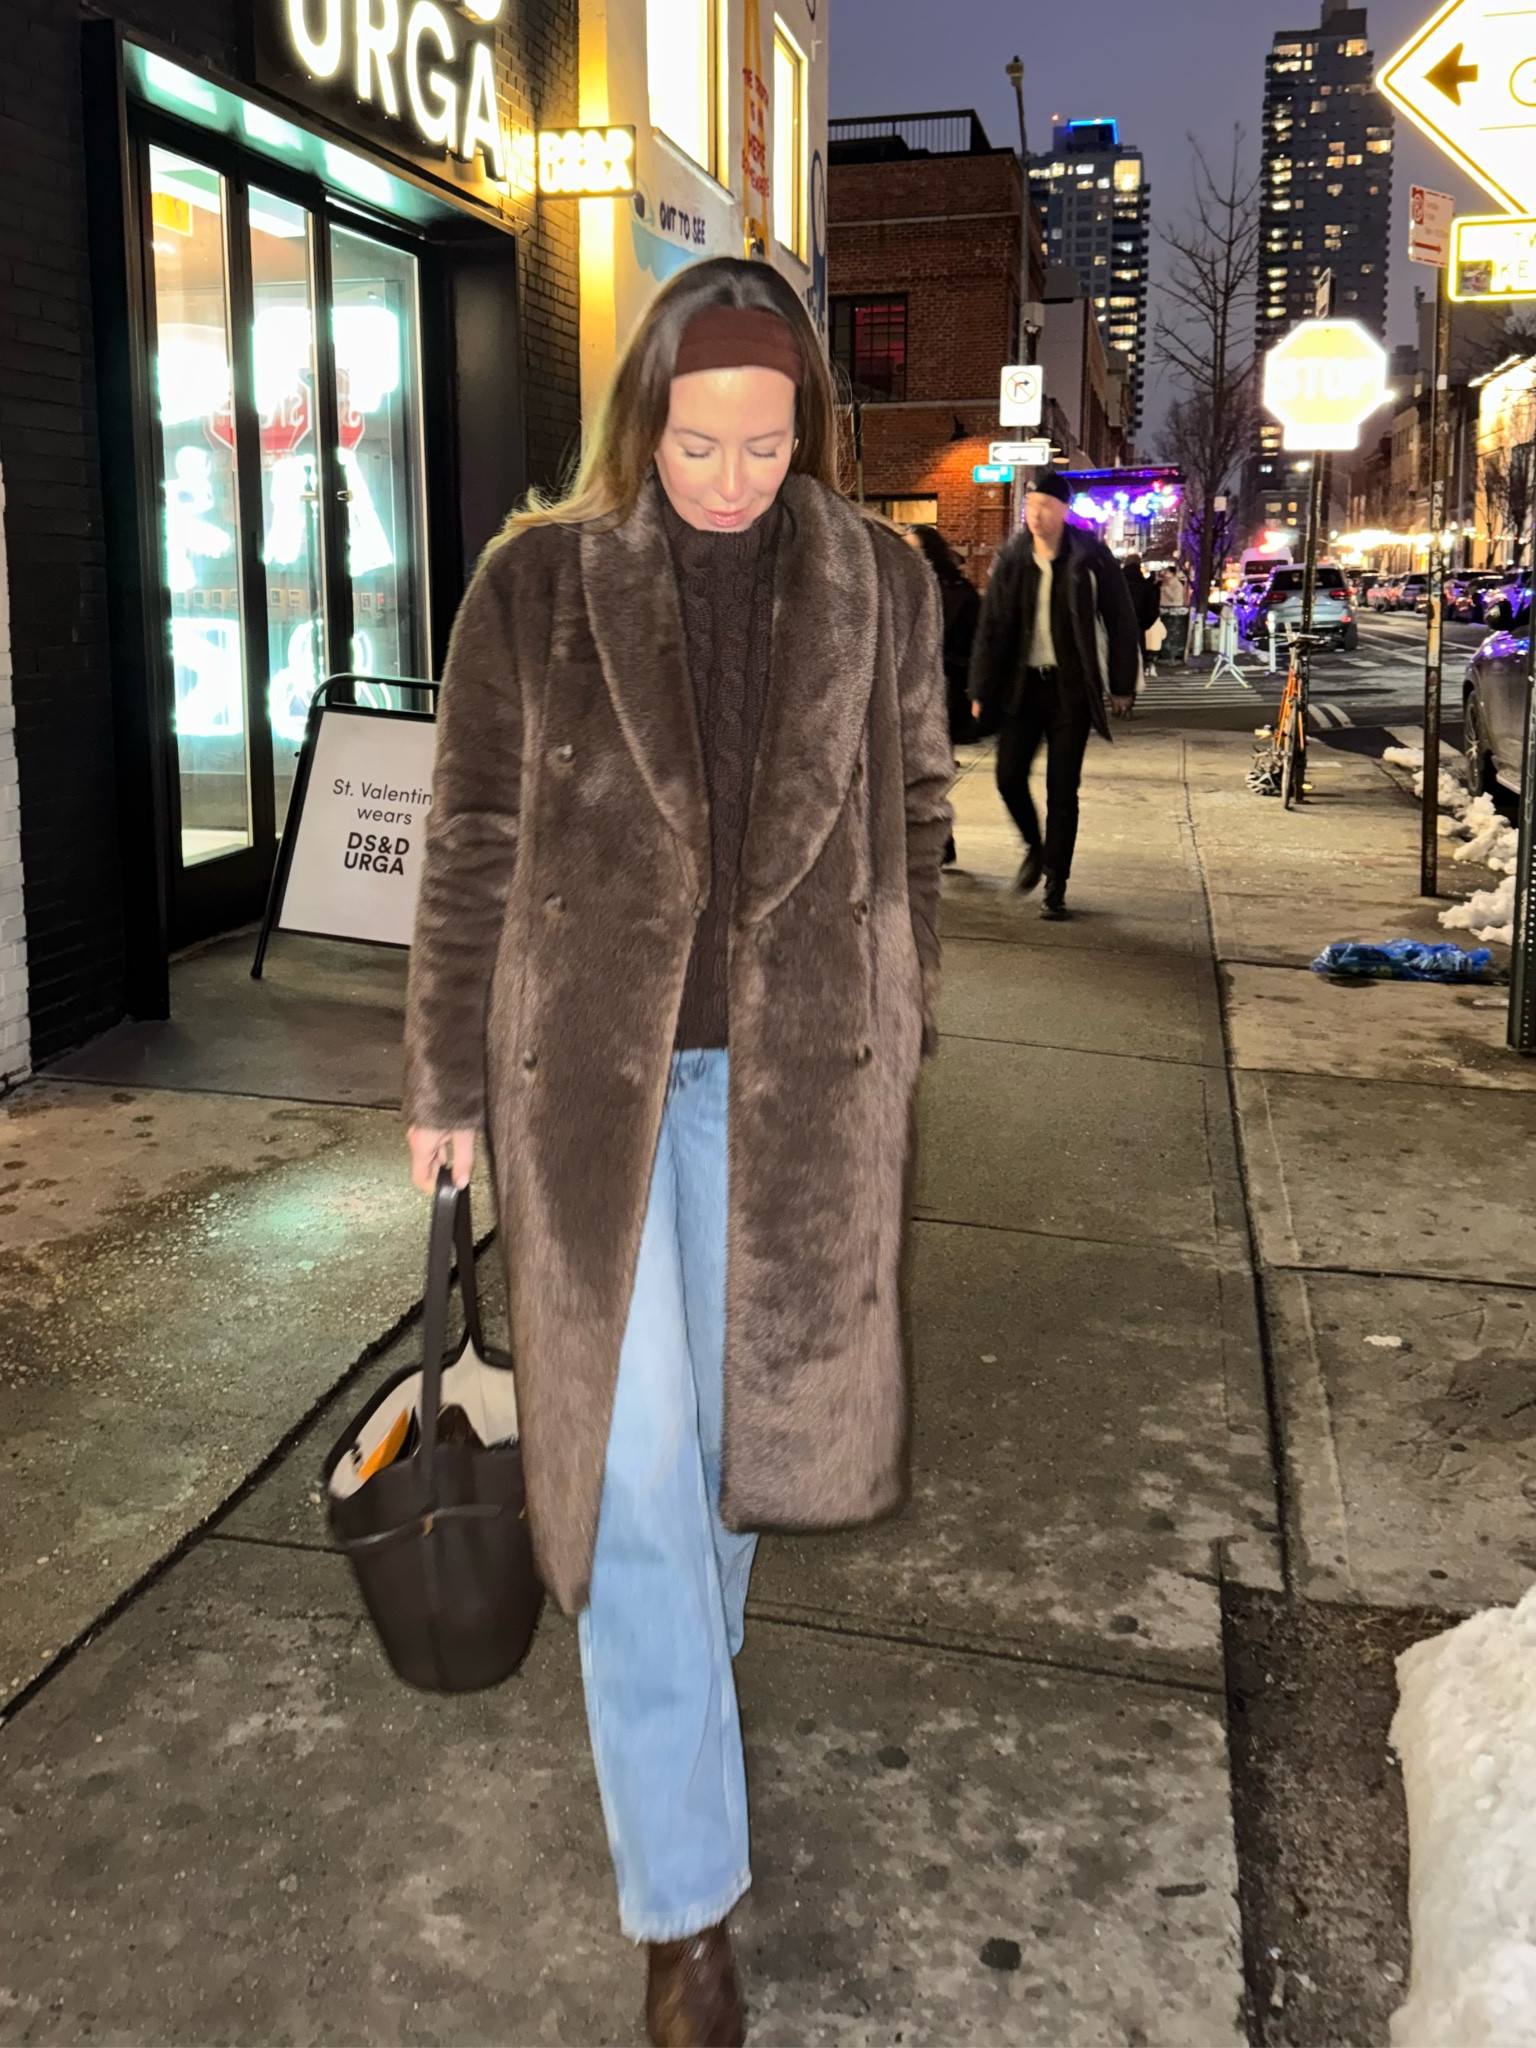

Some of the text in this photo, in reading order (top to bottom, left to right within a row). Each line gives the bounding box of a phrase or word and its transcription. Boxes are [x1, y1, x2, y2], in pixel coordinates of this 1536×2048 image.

[660, 201, 706, 245] OUT TO SEE
[1274, 356, 1374, 401] STOP
[332, 778, 354, 796] St.
[357, 807, 412, 825] wears
[347, 831, 410, 856] DS&D
[344, 851, 405, 875] URGA
